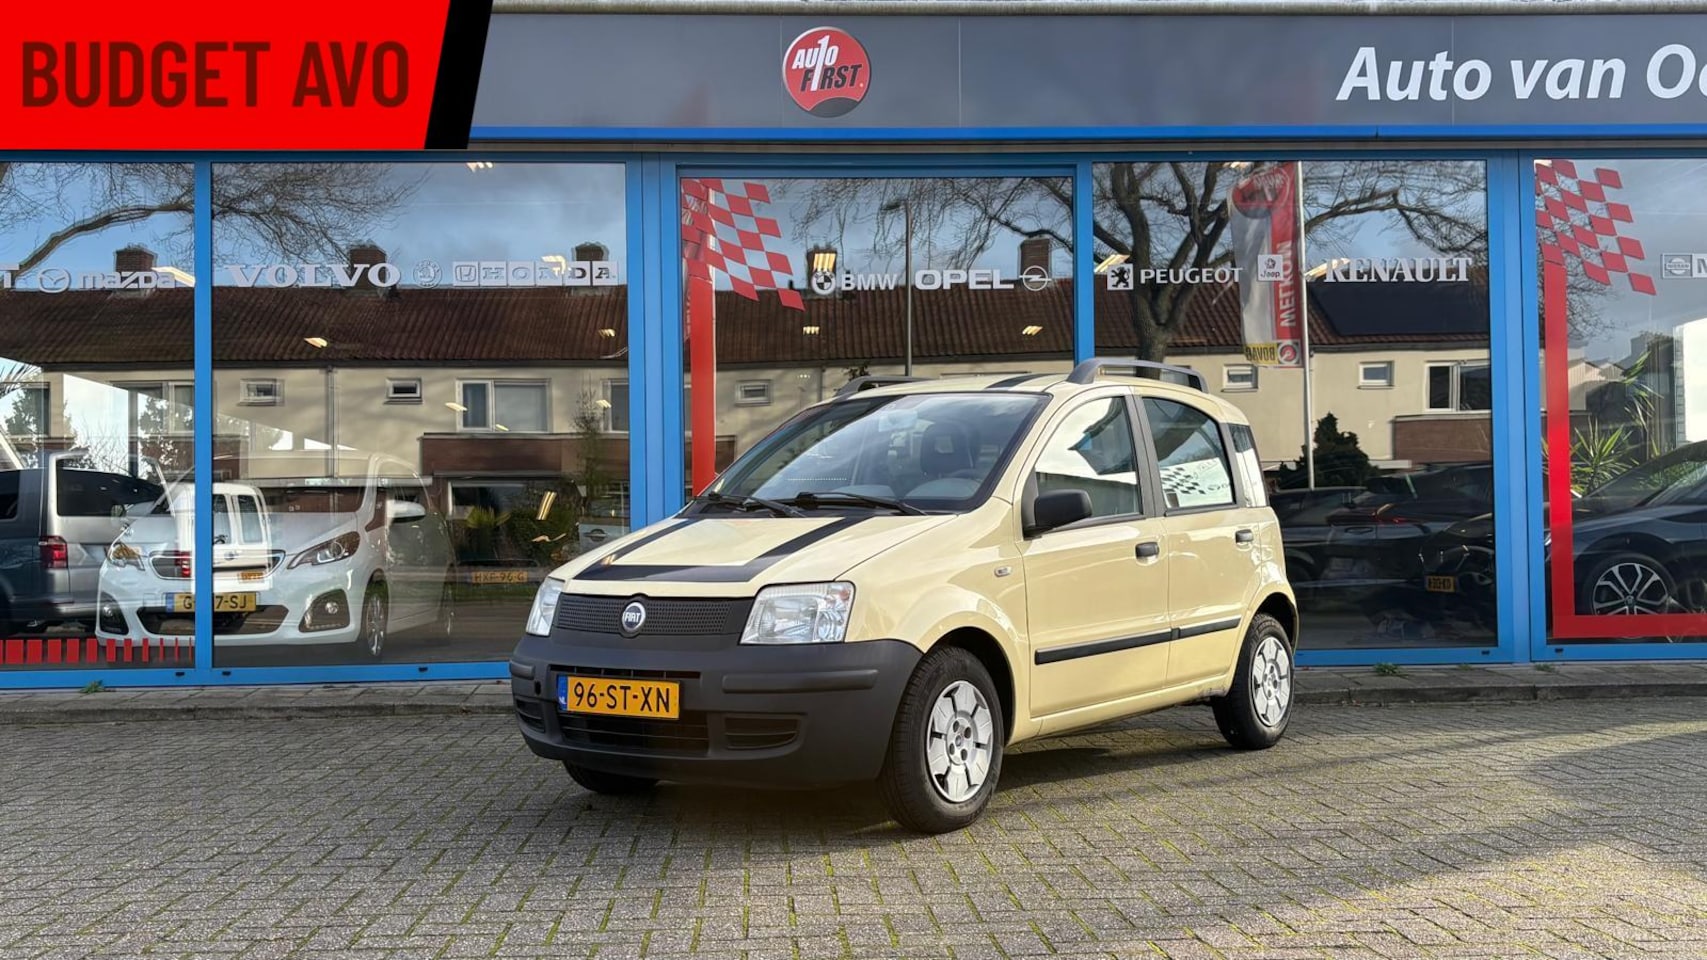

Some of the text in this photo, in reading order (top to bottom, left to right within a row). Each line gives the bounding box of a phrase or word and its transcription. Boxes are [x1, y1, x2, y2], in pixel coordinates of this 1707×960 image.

[1335, 43, 1707, 101] Auto van O
[78, 271, 175, 289] mazda
[223, 262, 401, 287] VOLVO
[481, 265, 613, 281] HONDA
[914, 269, 1015, 290] OPEL
[1139, 267, 1244, 284] PEUGEOT
[1323, 257, 1473, 283] RENAULT
[841, 272, 898, 291] BMW
[622, 612, 641, 623] FIAT
[573, 681, 670, 713] 96-ST-XN
